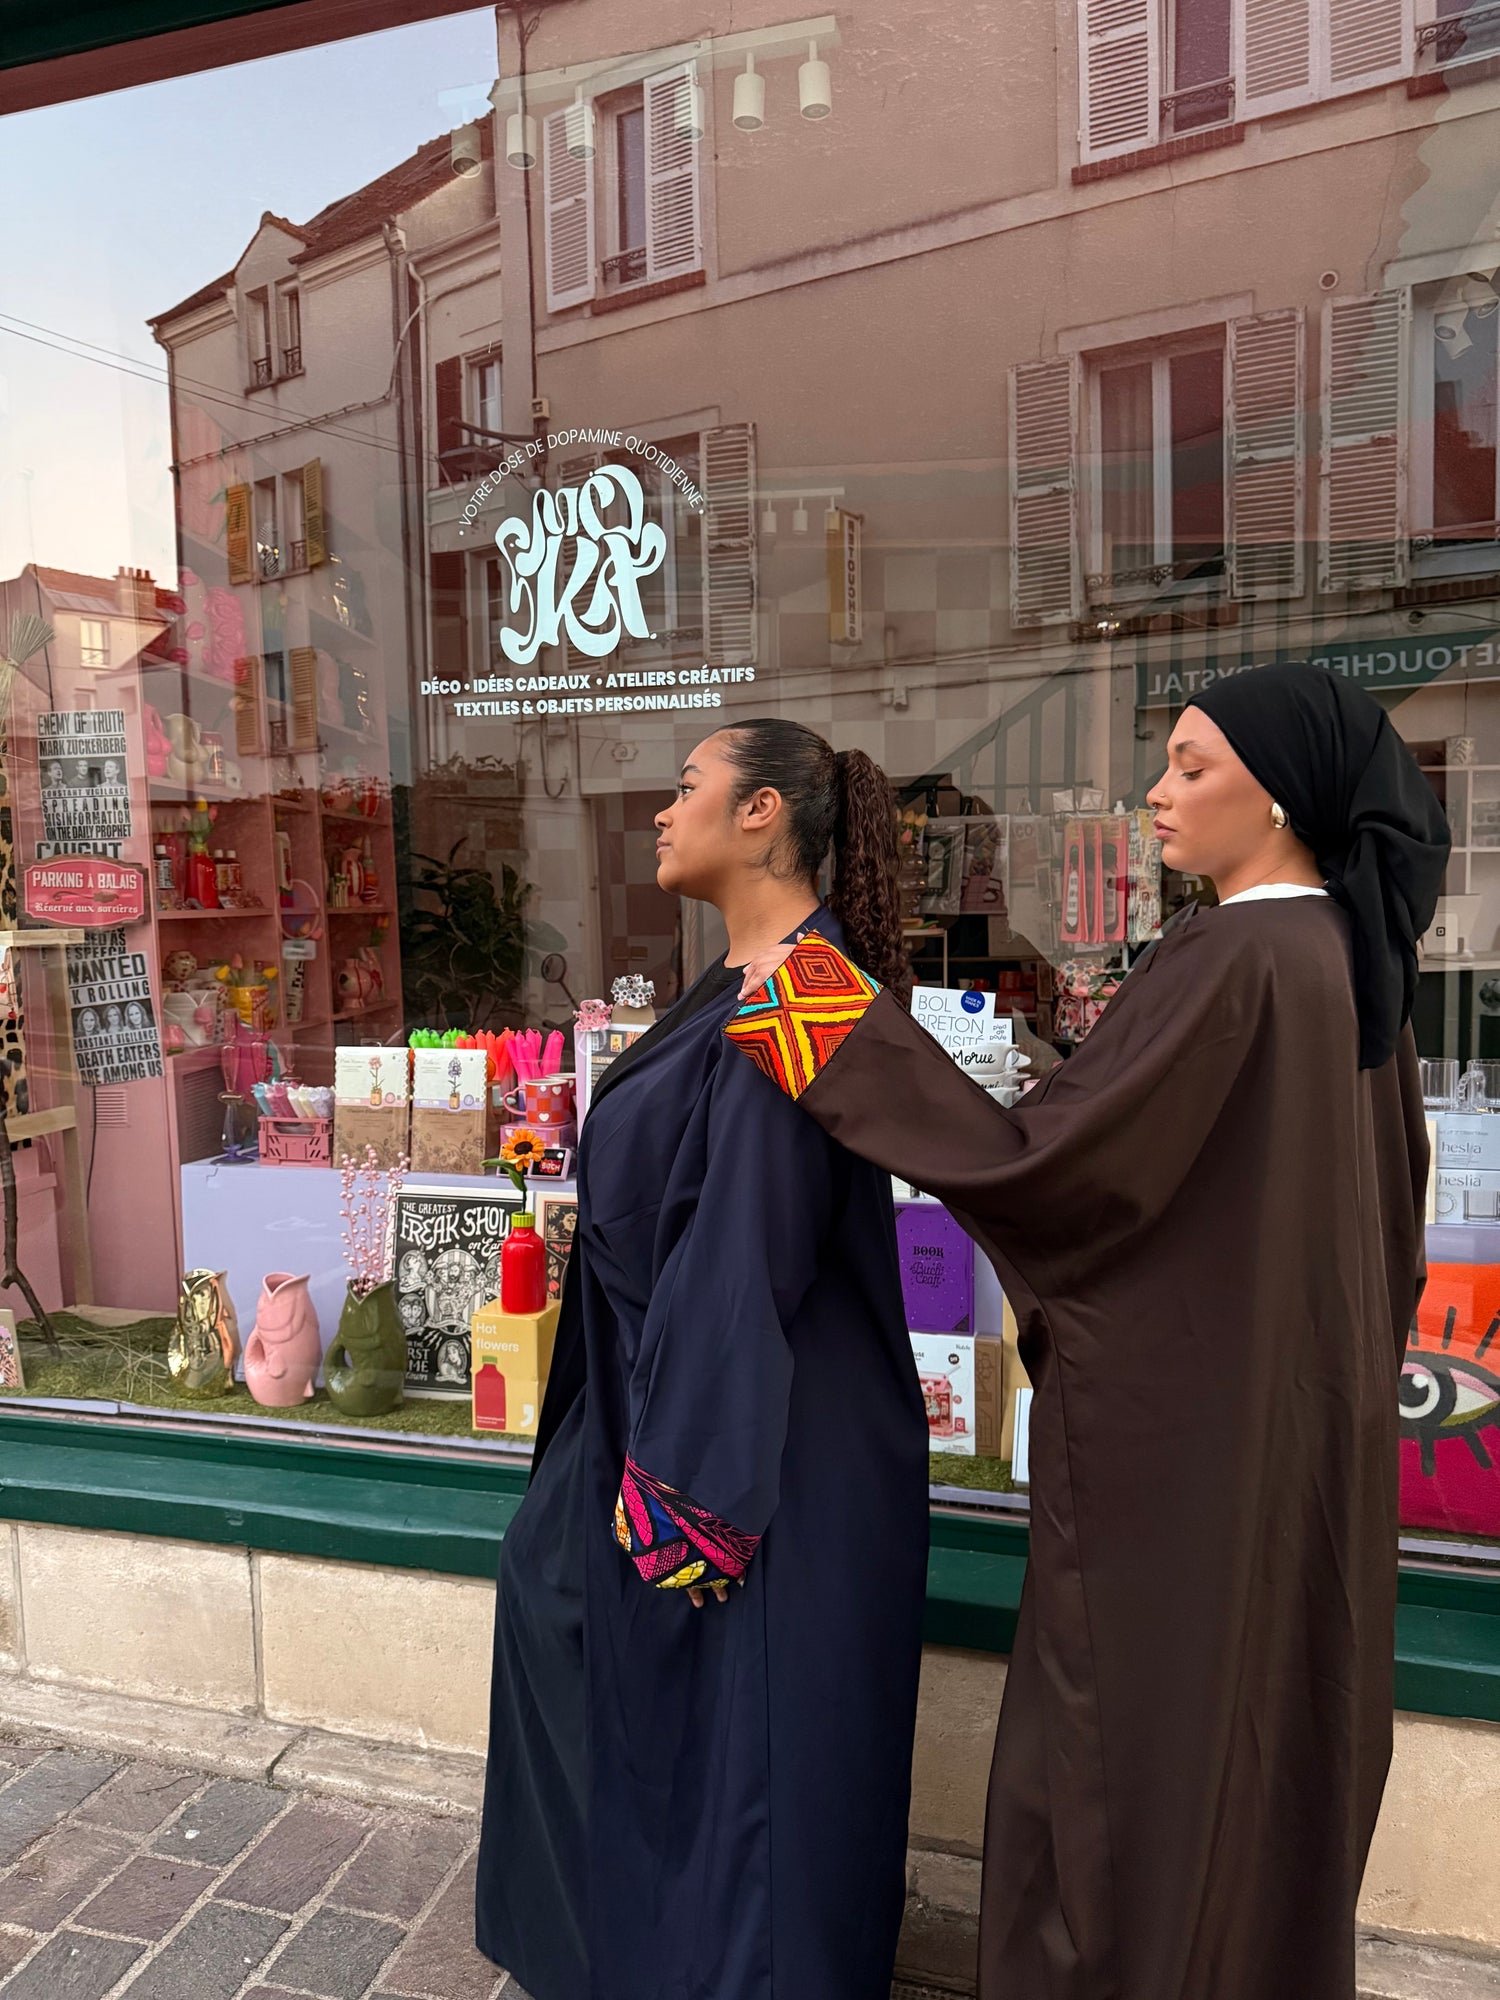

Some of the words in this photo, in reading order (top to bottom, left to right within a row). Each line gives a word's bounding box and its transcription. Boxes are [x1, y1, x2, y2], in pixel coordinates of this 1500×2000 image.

[459, 481, 494, 527] VOTRE
[489, 449, 525, 485] DOSE
[525, 438, 545, 458] DE
[547, 428, 623, 450] DOPAMINE
[625, 435, 704, 508] QUOTIDIENNE
[420, 676, 461, 696] DÉCO
[473, 673, 514, 694] IDÉES
[515, 674, 591, 692] CADEAUX
[605, 670, 676, 689] ATELIERS
[678, 663, 755, 686] CRÉATIFS
[453, 700, 519, 717] TEXTILES
[521, 699, 534, 715] &
[536, 697, 593, 714] OBJETS
[595, 688, 721, 712] PERSONNALISÉS
[38, 712, 70, 736] ENEMY
[73, 711, 87, 734] OF
[91, 709, 125, 733] TRUTH
[39, 739, 65, 757] MARK
[66, 736, 126, 756] ZUCKERBERG
[41, 788, 82, 798] CONSTANT
[86, 786, 128, 796] VIGILANCE
[42, 796, 129, 813] SPREADING
[44, 810, 131, 827] MISINFORMATION
[46, 827, 56, 841] ON
[57, 826, 71, 840] THE
[72, 825, 94, 839] DAILY
[96, 824, 131, 838] PROPHET
[32, 871, 83, 888] PARKING
[97, 873, 137, 890] BALAIS
[35, 901, 73, 912] Réservé
[75, 904, 94, 913] aux
[97, 903, 138, 914] sorcières
[87, 980, 150, 1003] ROLLING
[918, 994, 952, 1013] BOL
[917, 1013, 984, 1035] BRETON
[73, 1034, 114, 1050] CONSTANT
[116, 1028, 159, 1044] VIGILANCE
[76, 1048, 114, 1069] DEATH
[116, 1043, 161, 1064] EATERS
[952, 1049, 996, 1066] Morue
[80, 1068, 101, 1086] ARE
[103, 1062, 146, 1083] AMONG
[148, 1060, 163, 1077] US
[402, 1201, 416, 1212] THE
[418, 1203, 457, 1214] GREATEST
[400, 1209, 460, 1250] FREAK
[468, 1241, 481, 1250] on
[481, 1237, 503, 1257] Ear
[913, 1245, 944, 1258] BOOK
[475, 1321, 497, 1334] Hot
[408, 1346, 430, 1360] RST
[475, 1338, 520, 1352] flowers
